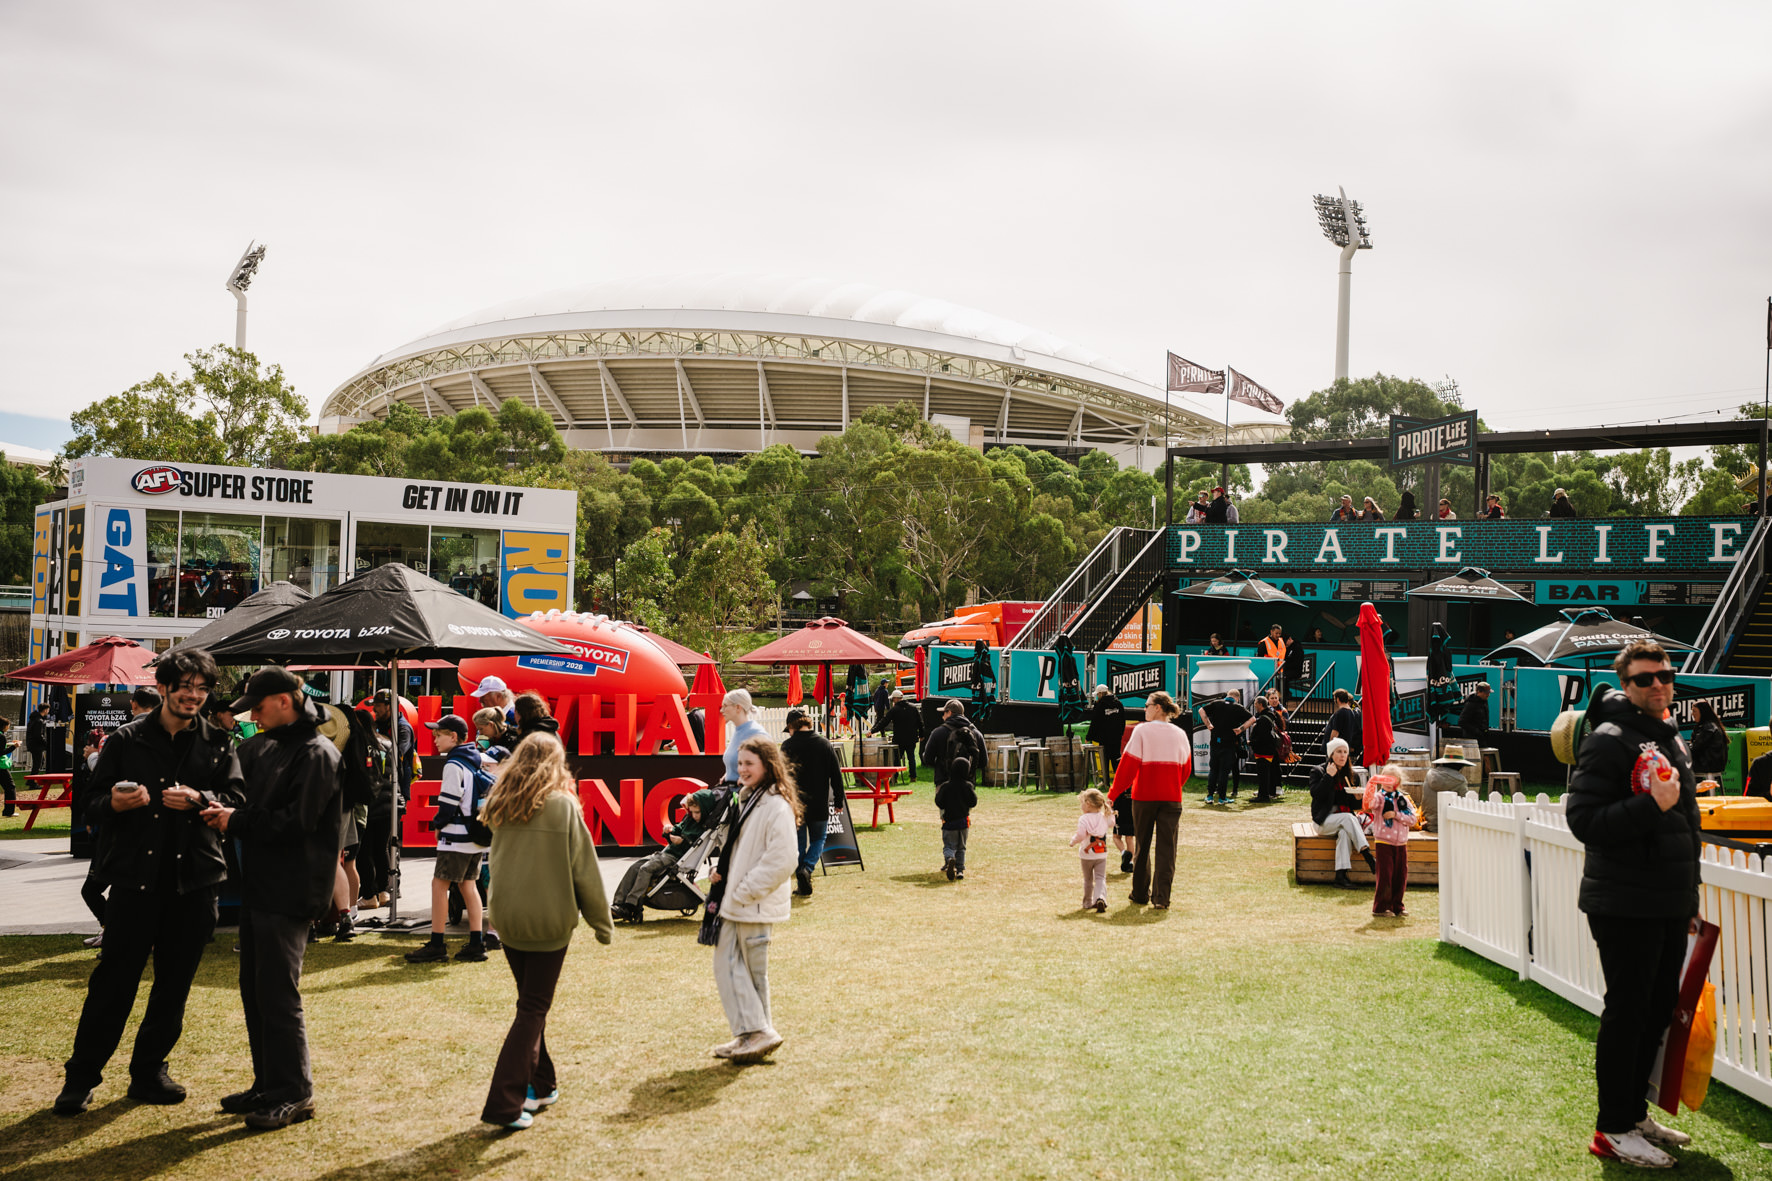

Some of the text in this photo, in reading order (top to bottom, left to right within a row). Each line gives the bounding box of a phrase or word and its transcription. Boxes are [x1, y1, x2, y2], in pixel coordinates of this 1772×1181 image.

[136, 470, 314, 504] AFL SUPER STORE
[402, 484, 524, 516] GET IN ON IT
[1176, 523, 1742, 563] PIRATE LIFE
[1548, 584, 1620, 601] BAR
[206, 606, 226, 619] EXIT
[293, 625, 395, 639] TOYOTA bZ4X
[1569, 632, 1654, 643] South Coast
[1113, 641, 1135, 649] mobile
[1574, 638, 1621, 649] PALE
[529, 657, 584, 670] PREMIERSHIP 2026
